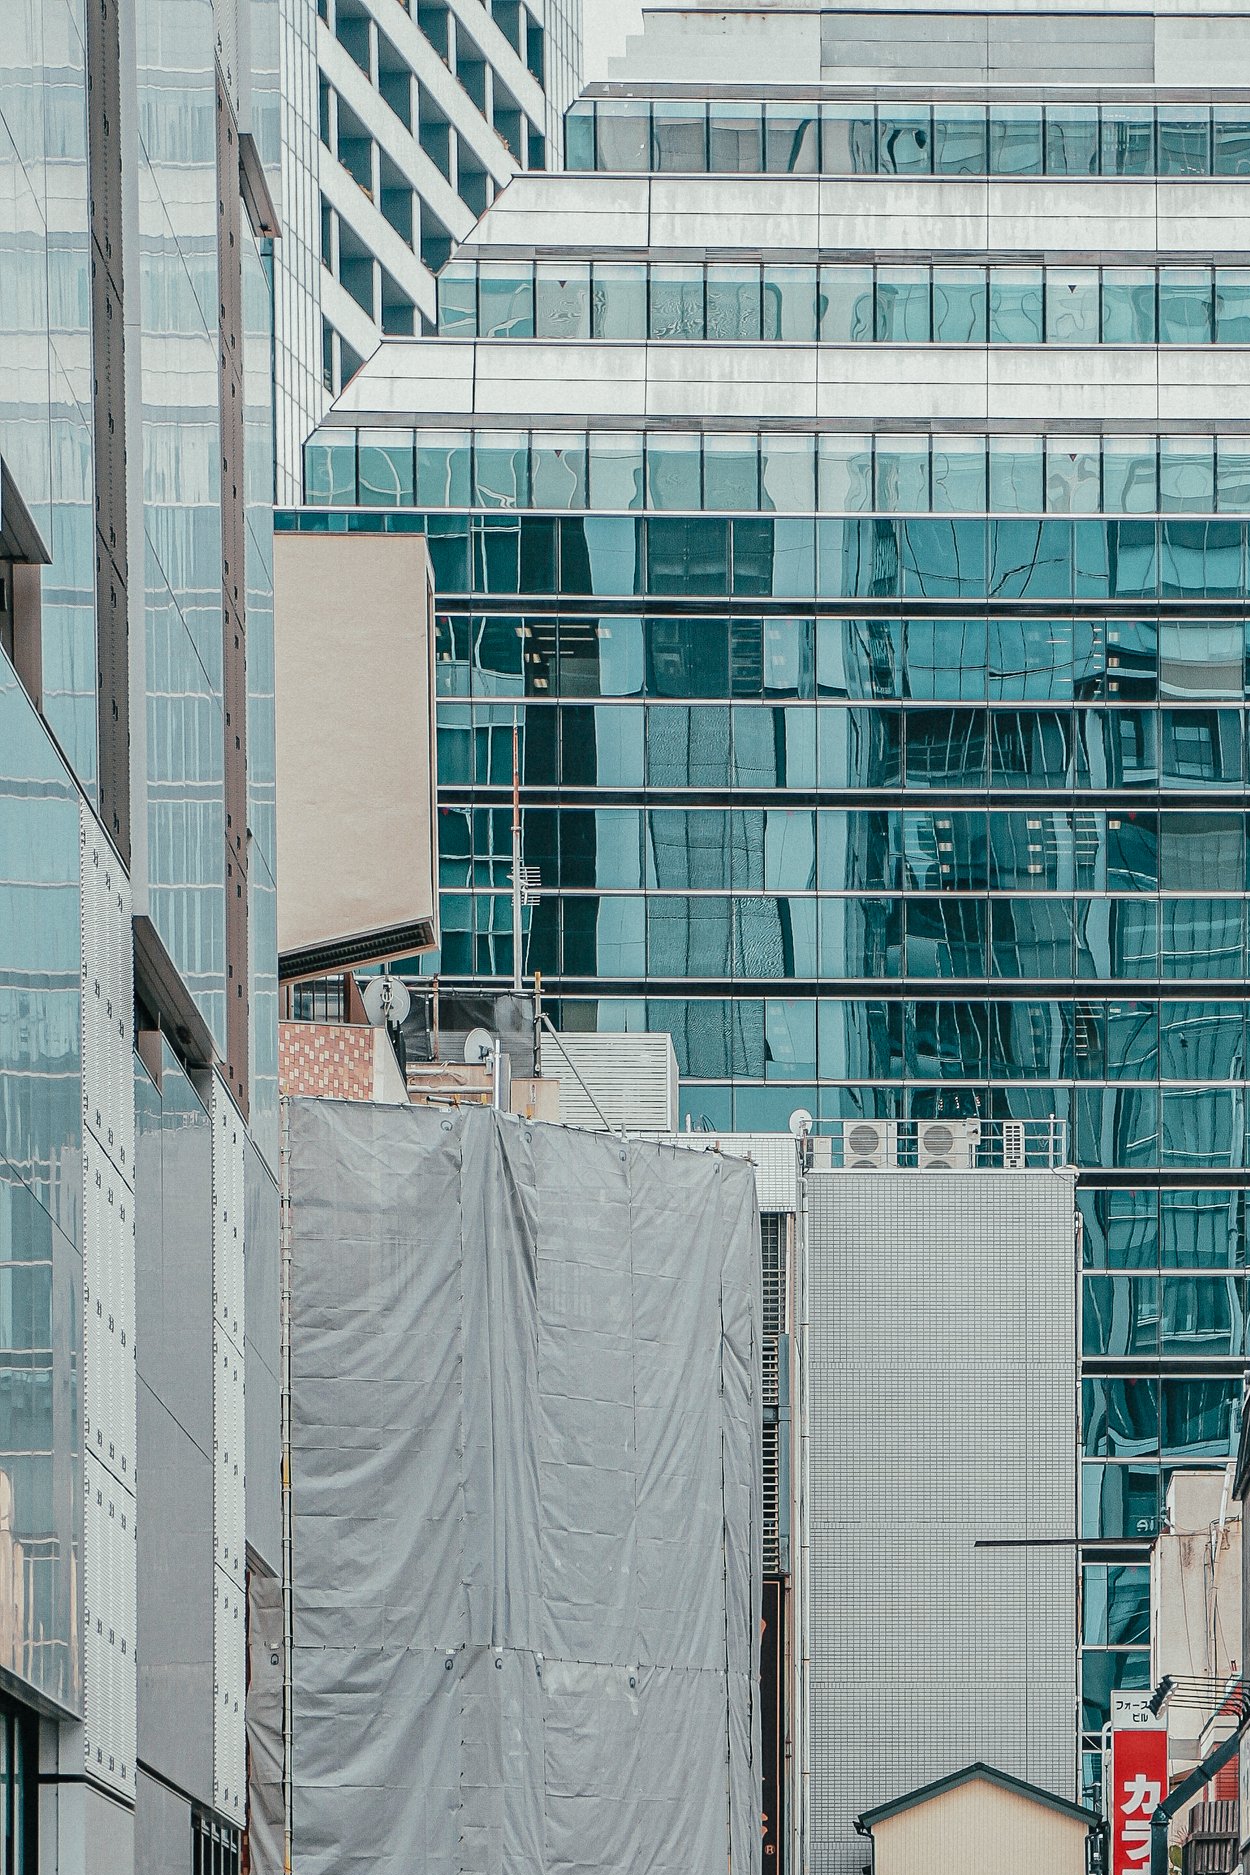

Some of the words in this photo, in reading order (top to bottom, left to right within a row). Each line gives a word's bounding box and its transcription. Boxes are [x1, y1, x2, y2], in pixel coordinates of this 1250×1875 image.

[1116, 1700, 1150, 1711] フォース
[1132, 1713, 1149, 1722] ビル
